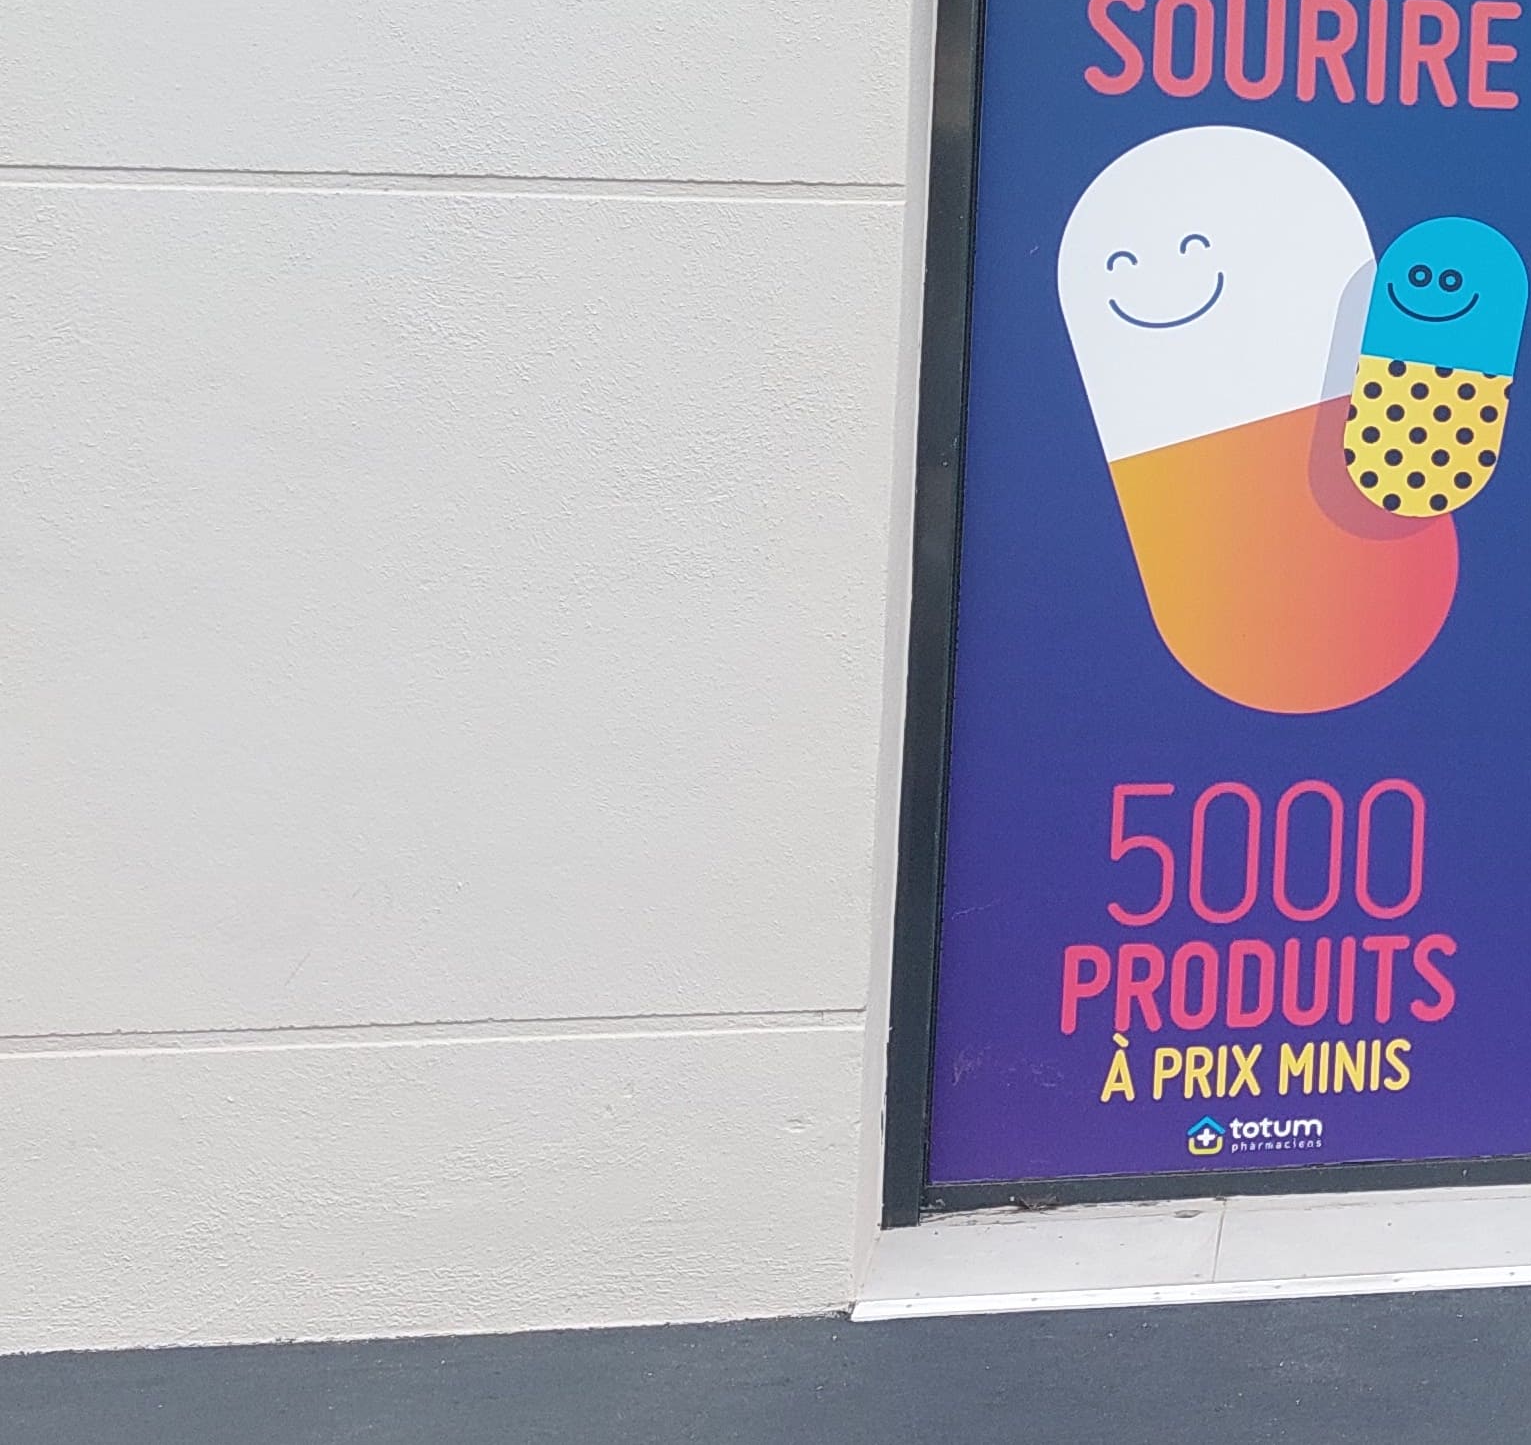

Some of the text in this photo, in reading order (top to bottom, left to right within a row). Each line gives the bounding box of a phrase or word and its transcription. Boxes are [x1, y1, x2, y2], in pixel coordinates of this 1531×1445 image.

[1106, 777, 1426, 927] 5000
[1060, 933, 1457, 1036] PRODUITS
[1101, 1032, 1412, 1103] À PRIX MINIS
[1229, 1117, 1323, 1138] totum
[1231, 1139, 1323, 1154] pharmaciens
